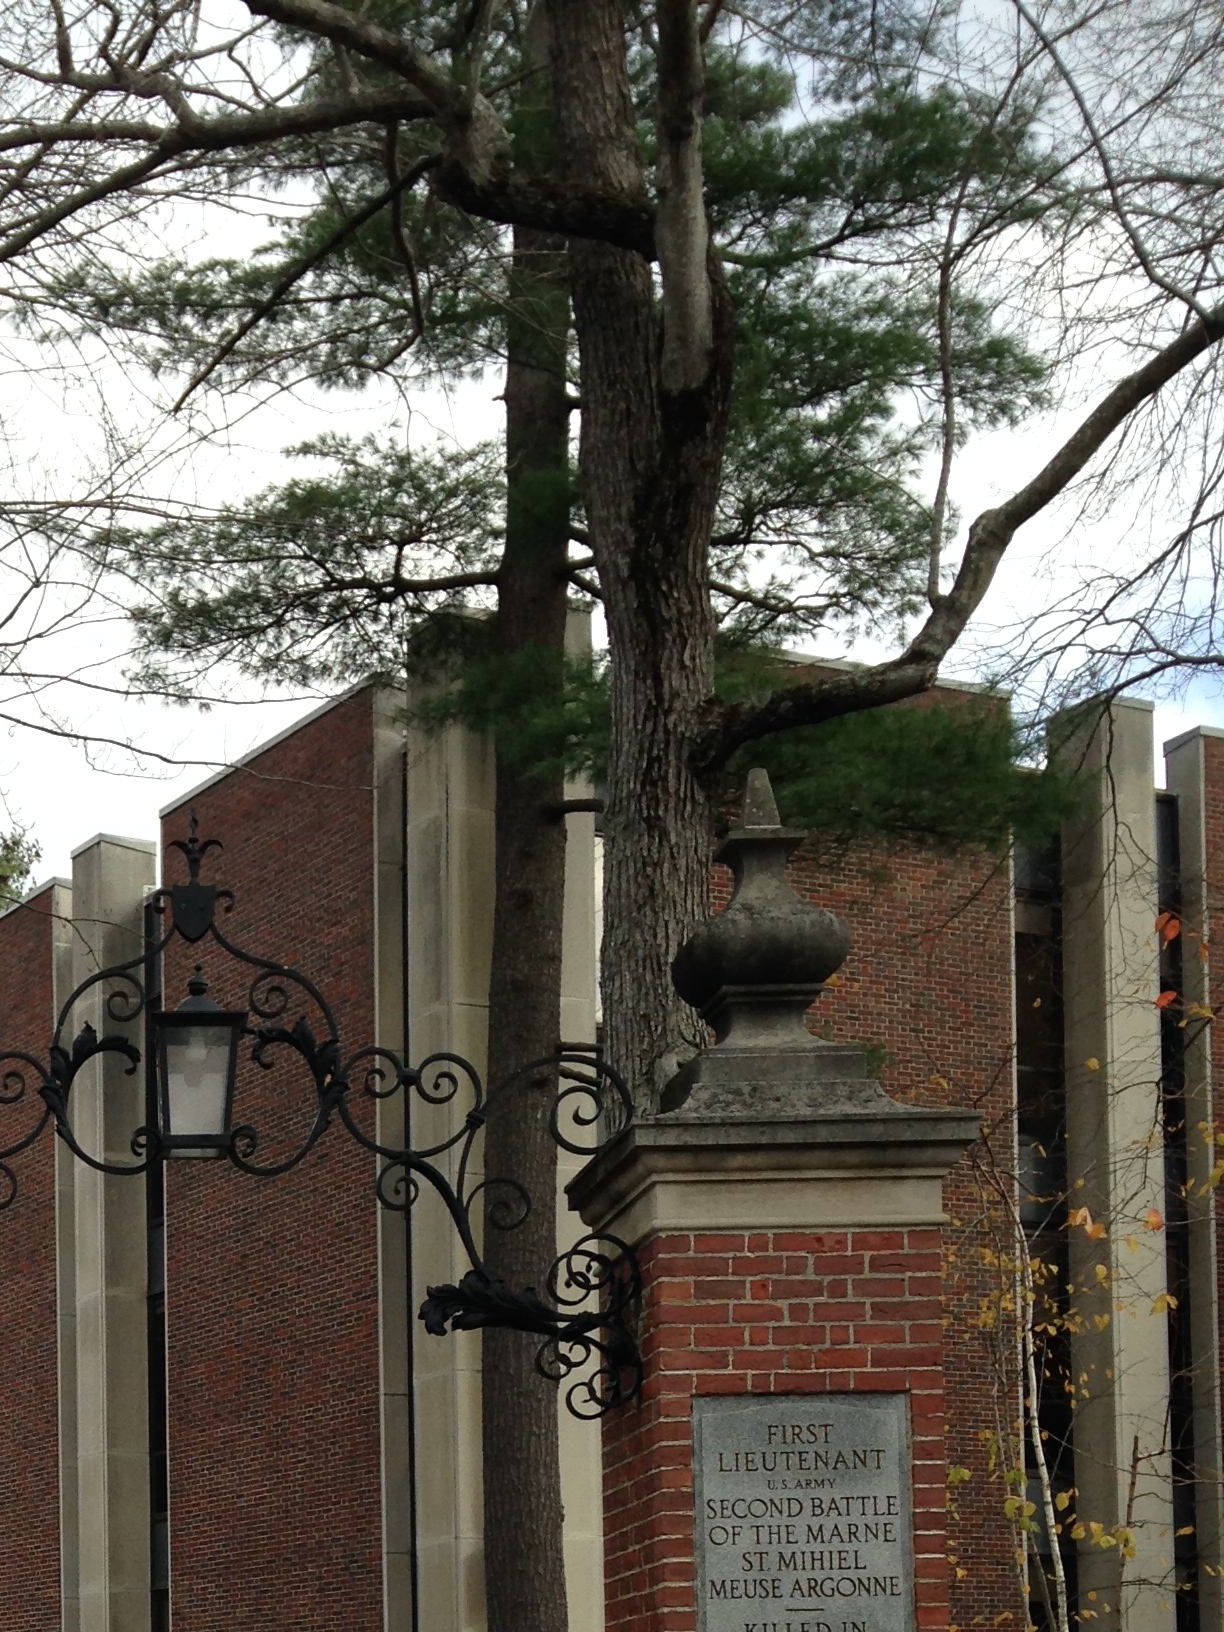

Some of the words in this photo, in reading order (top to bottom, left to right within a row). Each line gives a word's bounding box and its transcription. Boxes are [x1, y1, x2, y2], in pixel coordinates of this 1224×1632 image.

[767, 1424, 834, 1444] FIRST
[718, 1449, 886, 1472] LIEUTENANT
[794, 1479, 836, 1489] ARMY
[706, 1498, 803, 1519] SECOND
[811, 1496, 899, 1517] BATTLE
[709, 1525, 742, 1545] OF
[750, 1524, 799, 1545] THE
[805, 1523, 897, 1543] MARNE
[778, 1550, 867, 1570] MIHIEL
[709, 1579, 783, 1599] MEUSE
[790, 1577, 902, 1598] ARGONNE
